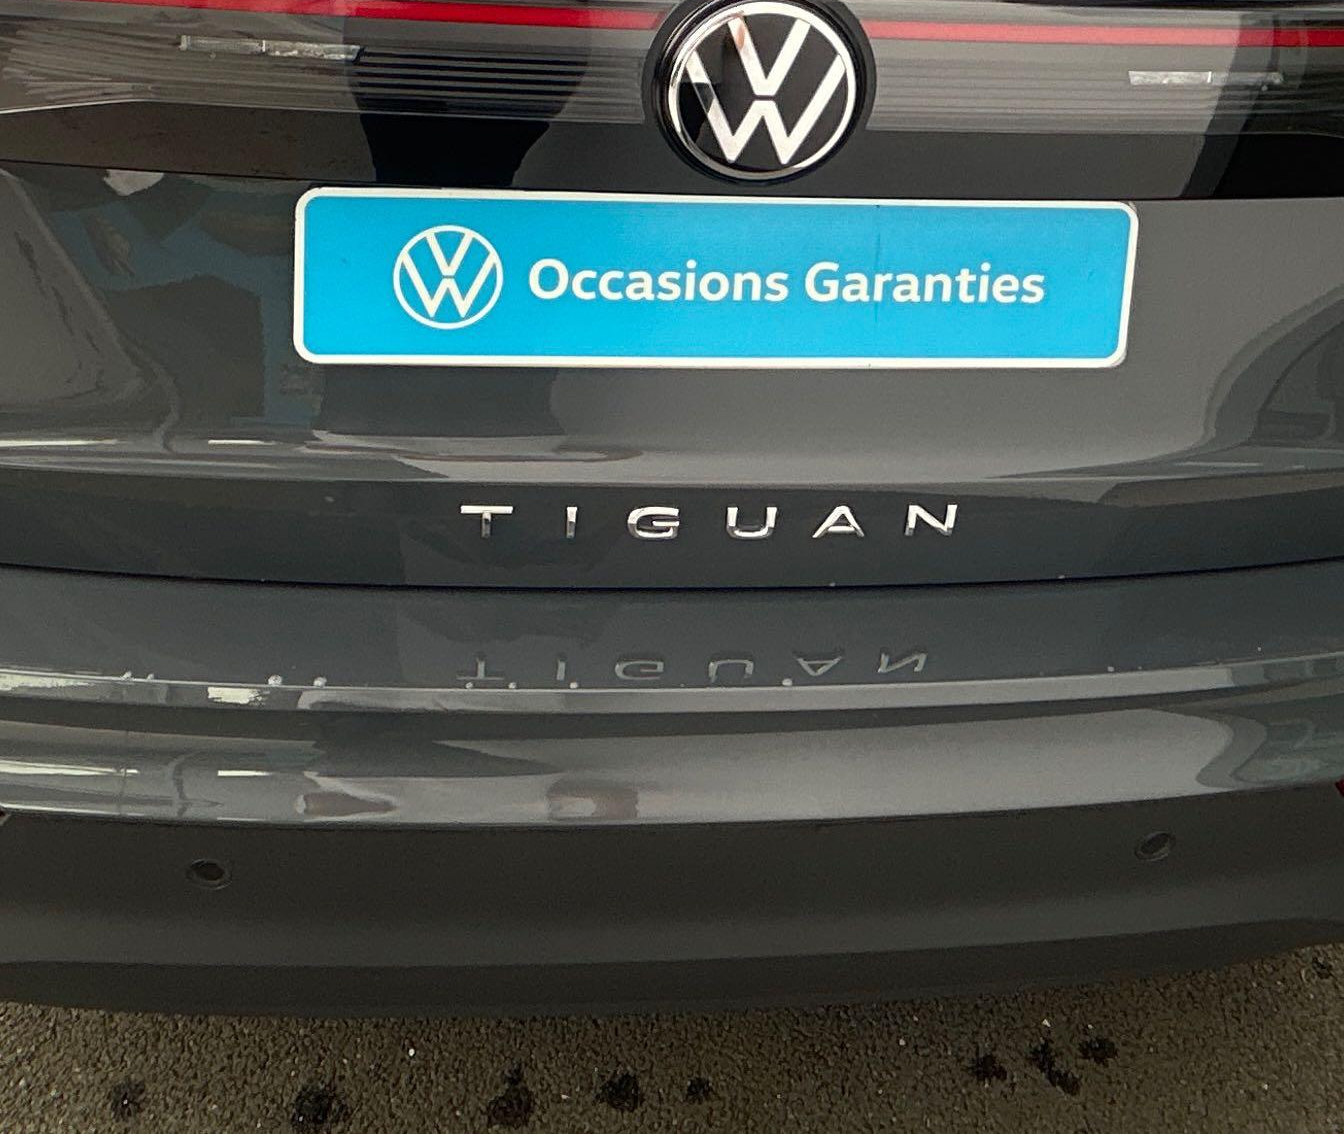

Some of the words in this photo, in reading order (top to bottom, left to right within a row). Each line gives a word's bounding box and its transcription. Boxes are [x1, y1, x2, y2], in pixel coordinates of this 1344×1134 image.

[529, 258, 789, 302] Occasions
[804, 260, 1046, 304] Garanties
[460, 503, 960, 540] TIGUAN
